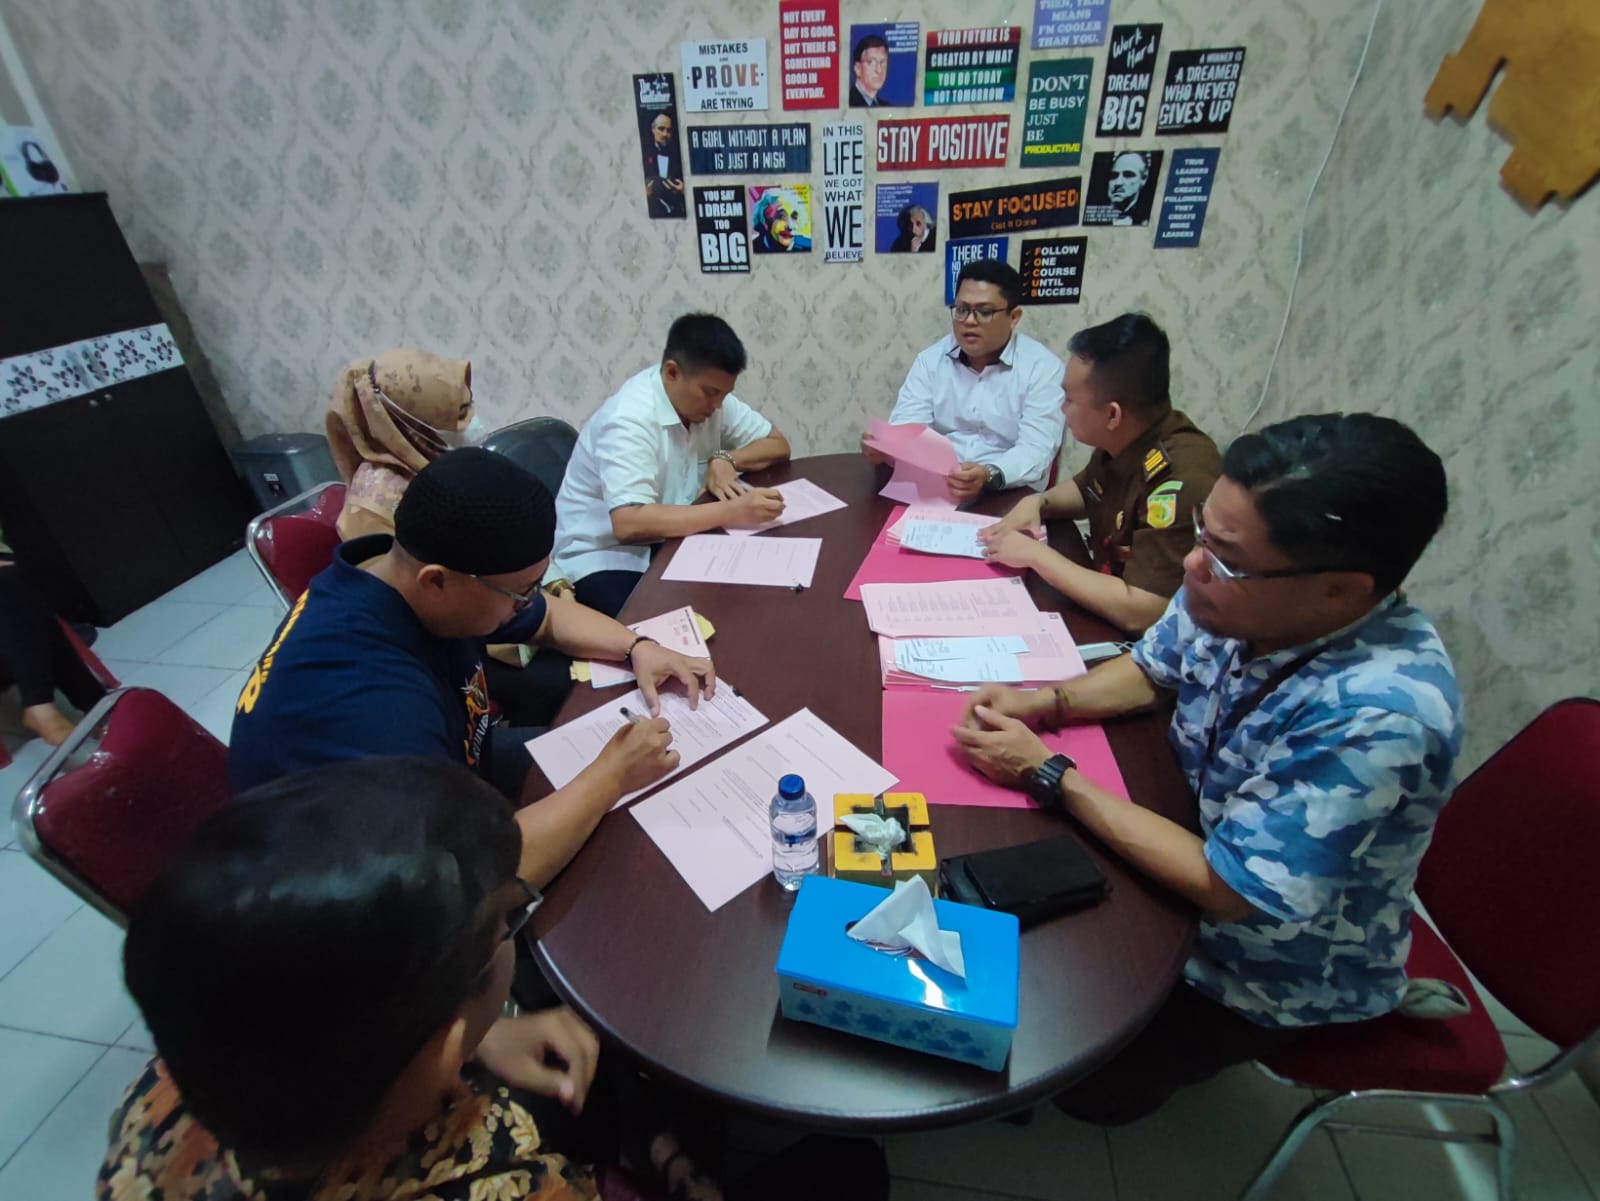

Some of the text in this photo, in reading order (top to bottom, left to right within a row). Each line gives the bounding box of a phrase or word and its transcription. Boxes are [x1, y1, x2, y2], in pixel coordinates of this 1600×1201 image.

[784, 10, 826, 24] NOT EVERY
[784, 27, 800, 40] DAY
[800, 26, 809, 38] IS
[1057, 20, 1102, 33] COOLER
[936, 27, 1010, 46] YOUR FUTURE IS
[1038, 33, 1099, 48] THAN YOU.
[698, 42, 748, 56] MISTAKES
[784, 41, 836, 55] BUT THERE IS
[784, 56, 831, 70] SOMETHING
[931, 48, 1013, 68] CREATED BY WHAT
[692, 64, 760, 89] PROVE
[786, 73, 808, 85] GOOD
[938, 70, 1002, 86] YOU DO TODAY
[1175, 63, 1240, 83] A DREAMER
[1031, 74, 1088, 92] DON'T
[1108, 73, 1150, 92] DREAM
[934, 87, 1004, 104] NOT TOMORROW
[1164, 81, 1236, 102] WHO NEVER
[701, 97, 754, 110] ARE TRYING
[1029, 96, 1085, 110] BE BUSY
[1101, 94, 1145, 130] BIG
[1159, 100, 1232, 125] GIVES UP
[1026, 113, 1058, 126] JUST
[822, 125, 863, 136] IN THIS
[1026, 128, 1044, 142] BE
[692, 128, 806, 148] A GOAL WITHOUT A PLAN
[878, 122, 1008, 163] STAY POSITIVE
[1024, 143, 1080, 154] PRODUCTIVE
[714, 152, 786, 170] IS JUST A WISH
[824, 140, 863, 176] LIFE
[1176, 168, 1209, 176] LEADERS
[824, 178, 862, 188] WE GOT
[703, 190, 735, 202] YOU SAY
[824, 190, 862, 202] WHAT
[698, 202, 744, 218] I DREAM
[952, 199, 992, 222] STAY
[998, 188, 1078, 216] FOCUSED
[714, 220, 730, 230] TOO
[825, 205, 862, 248] WE
[700, 232, 748, 264] BIG
[826, 250, 862, 260] BELIEVE
[952, 243, 998, 261] THERE IS
[1034, 246, 1080, 256] FOLLOW
[952, 261, 961, 272] NO
[1034, 257, 1057, 266] ONE
[1032, 267, 1077, 277] COURSE
[1032, 278, 1064, 287] UNTIL
[1031, 287, 1080, 298] SUCCESS
